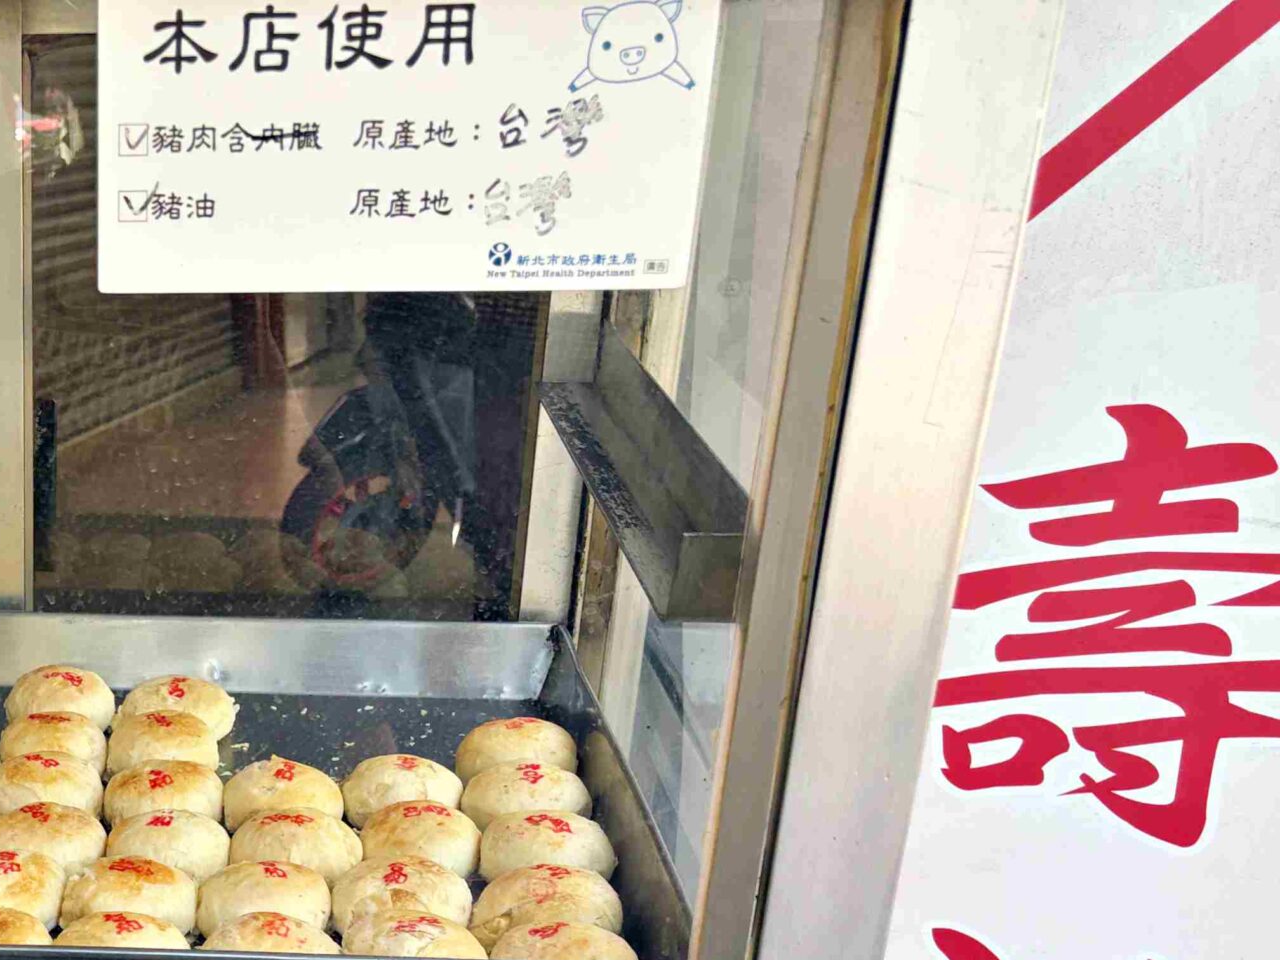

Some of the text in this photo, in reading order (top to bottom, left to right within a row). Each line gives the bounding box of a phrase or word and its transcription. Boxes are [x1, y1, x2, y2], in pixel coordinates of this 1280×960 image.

[143, 2, 477, 74] 本店使用
[150, 191, 216, 220] 豬油
[486, 268, 636, 281] New Taipei Health Department
